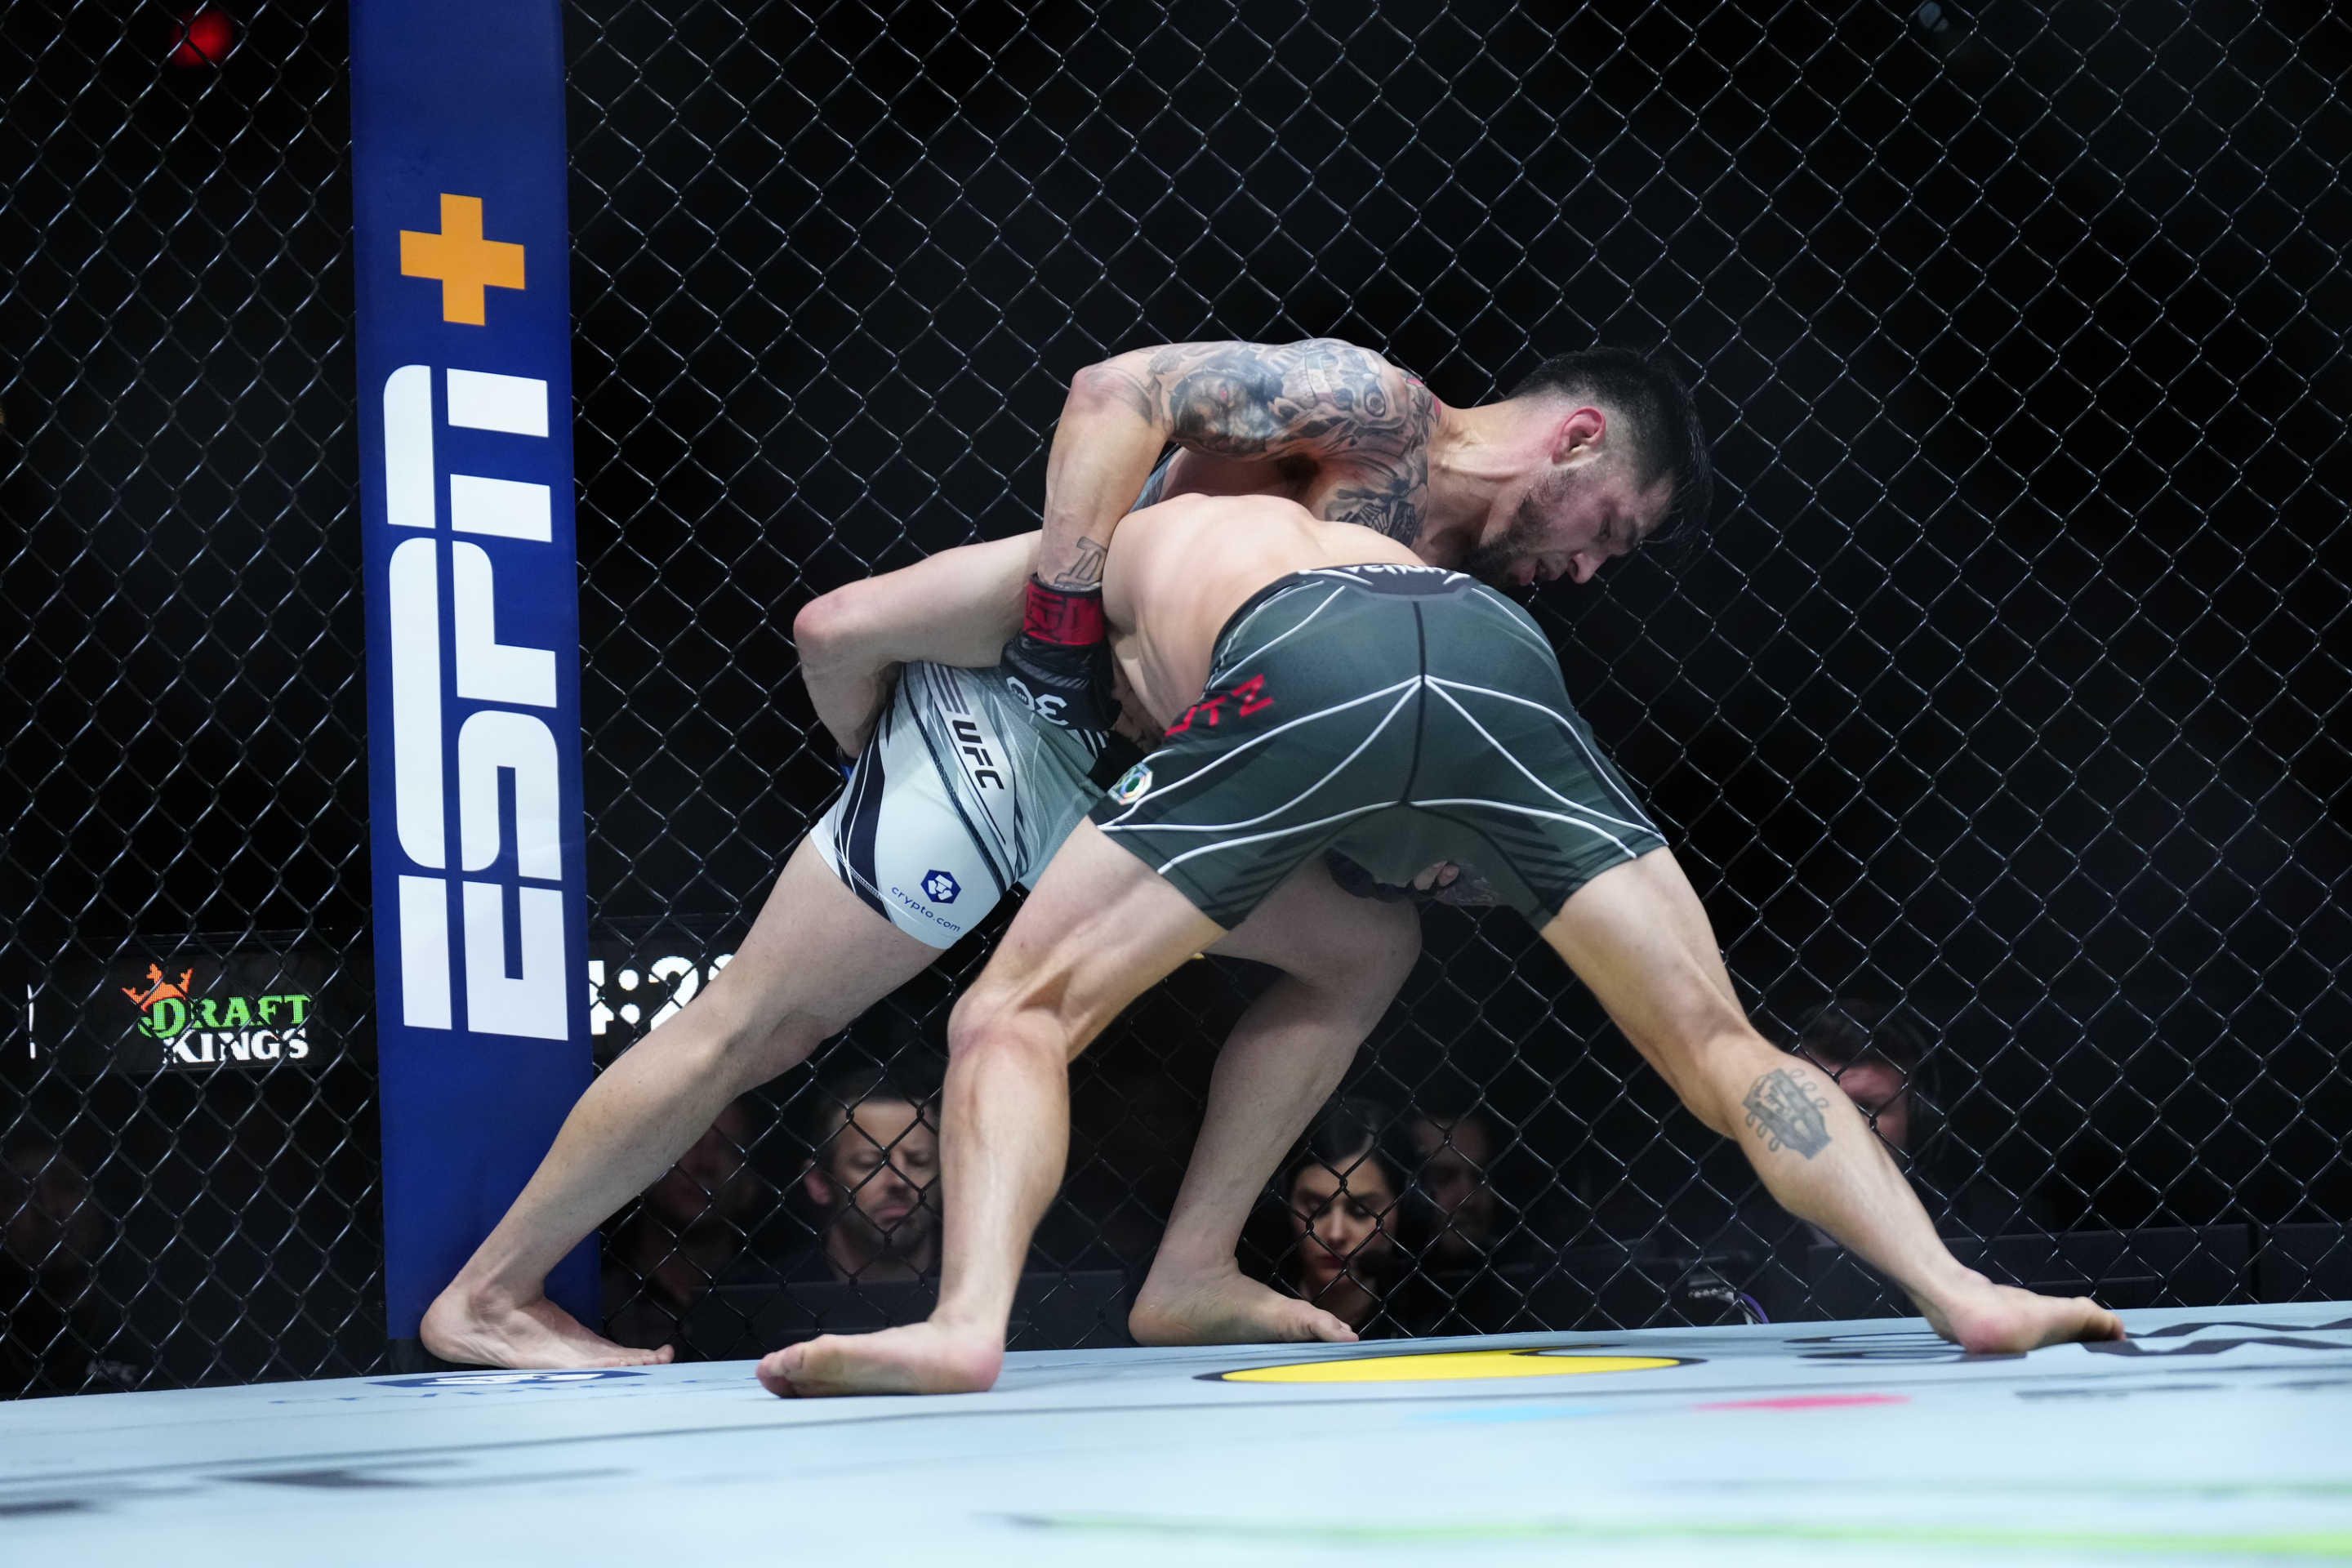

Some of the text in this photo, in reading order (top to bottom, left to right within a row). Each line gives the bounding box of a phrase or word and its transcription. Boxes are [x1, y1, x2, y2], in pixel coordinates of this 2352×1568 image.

[952, 719, 1004, 790] UFC
[891, 887, 960, 932] crypto.com
[137, 995, 311, 1039] DRAFT
[163, 1027, 309, 1063] KINGS
